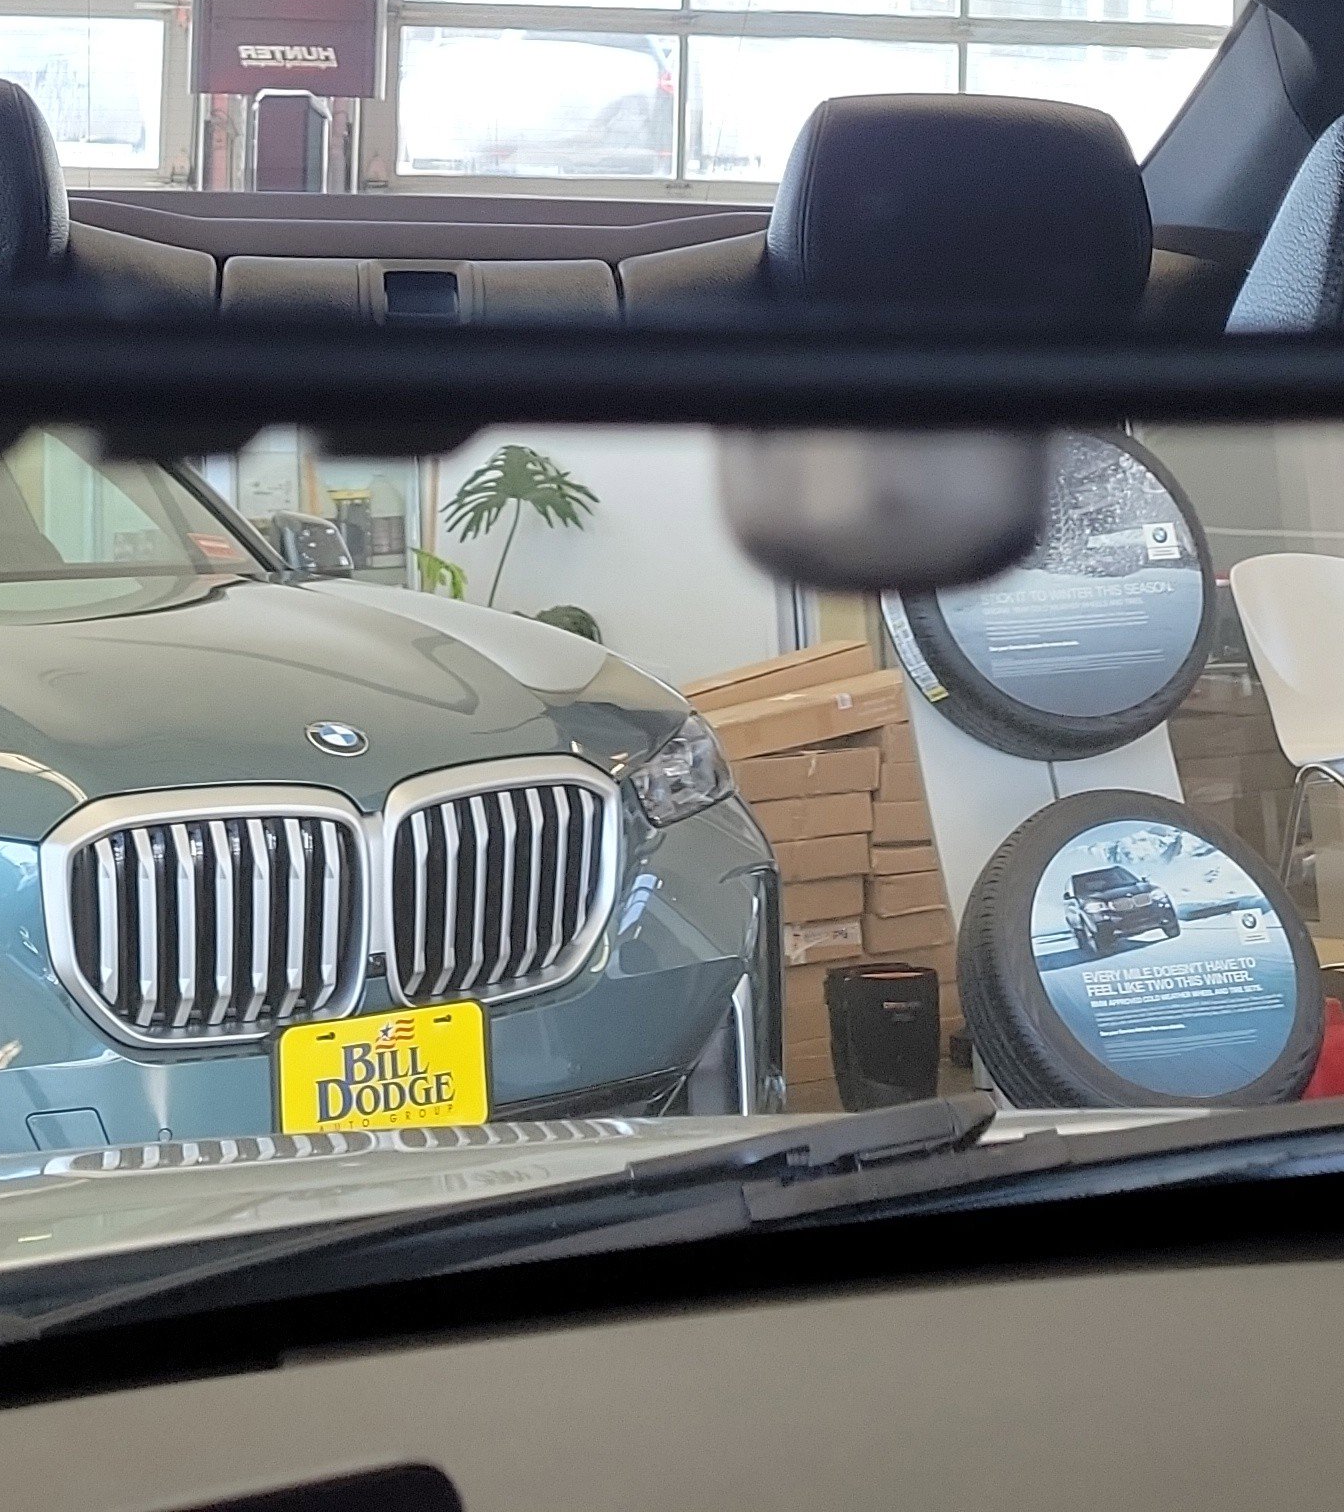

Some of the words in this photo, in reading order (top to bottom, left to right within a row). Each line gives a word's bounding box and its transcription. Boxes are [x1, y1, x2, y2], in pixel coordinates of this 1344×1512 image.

[1082, 970, 1122, 983] EVERY
[1123, 967, 1153, 981] MILE
[1206, 958, 1238, 972] HAVE
[1238, 956, 1256, 969] TO
[1086, 984, 1118, 997] FEEL
[1118, 981, 1147, 995] LIKE
[1146, 978, 1174, 992] TWO
[1174, 975, 1203, 989] THIS
[319, 1118, 370, 1132] AUTO
[389, 1104, 454, 1124] GROUP
